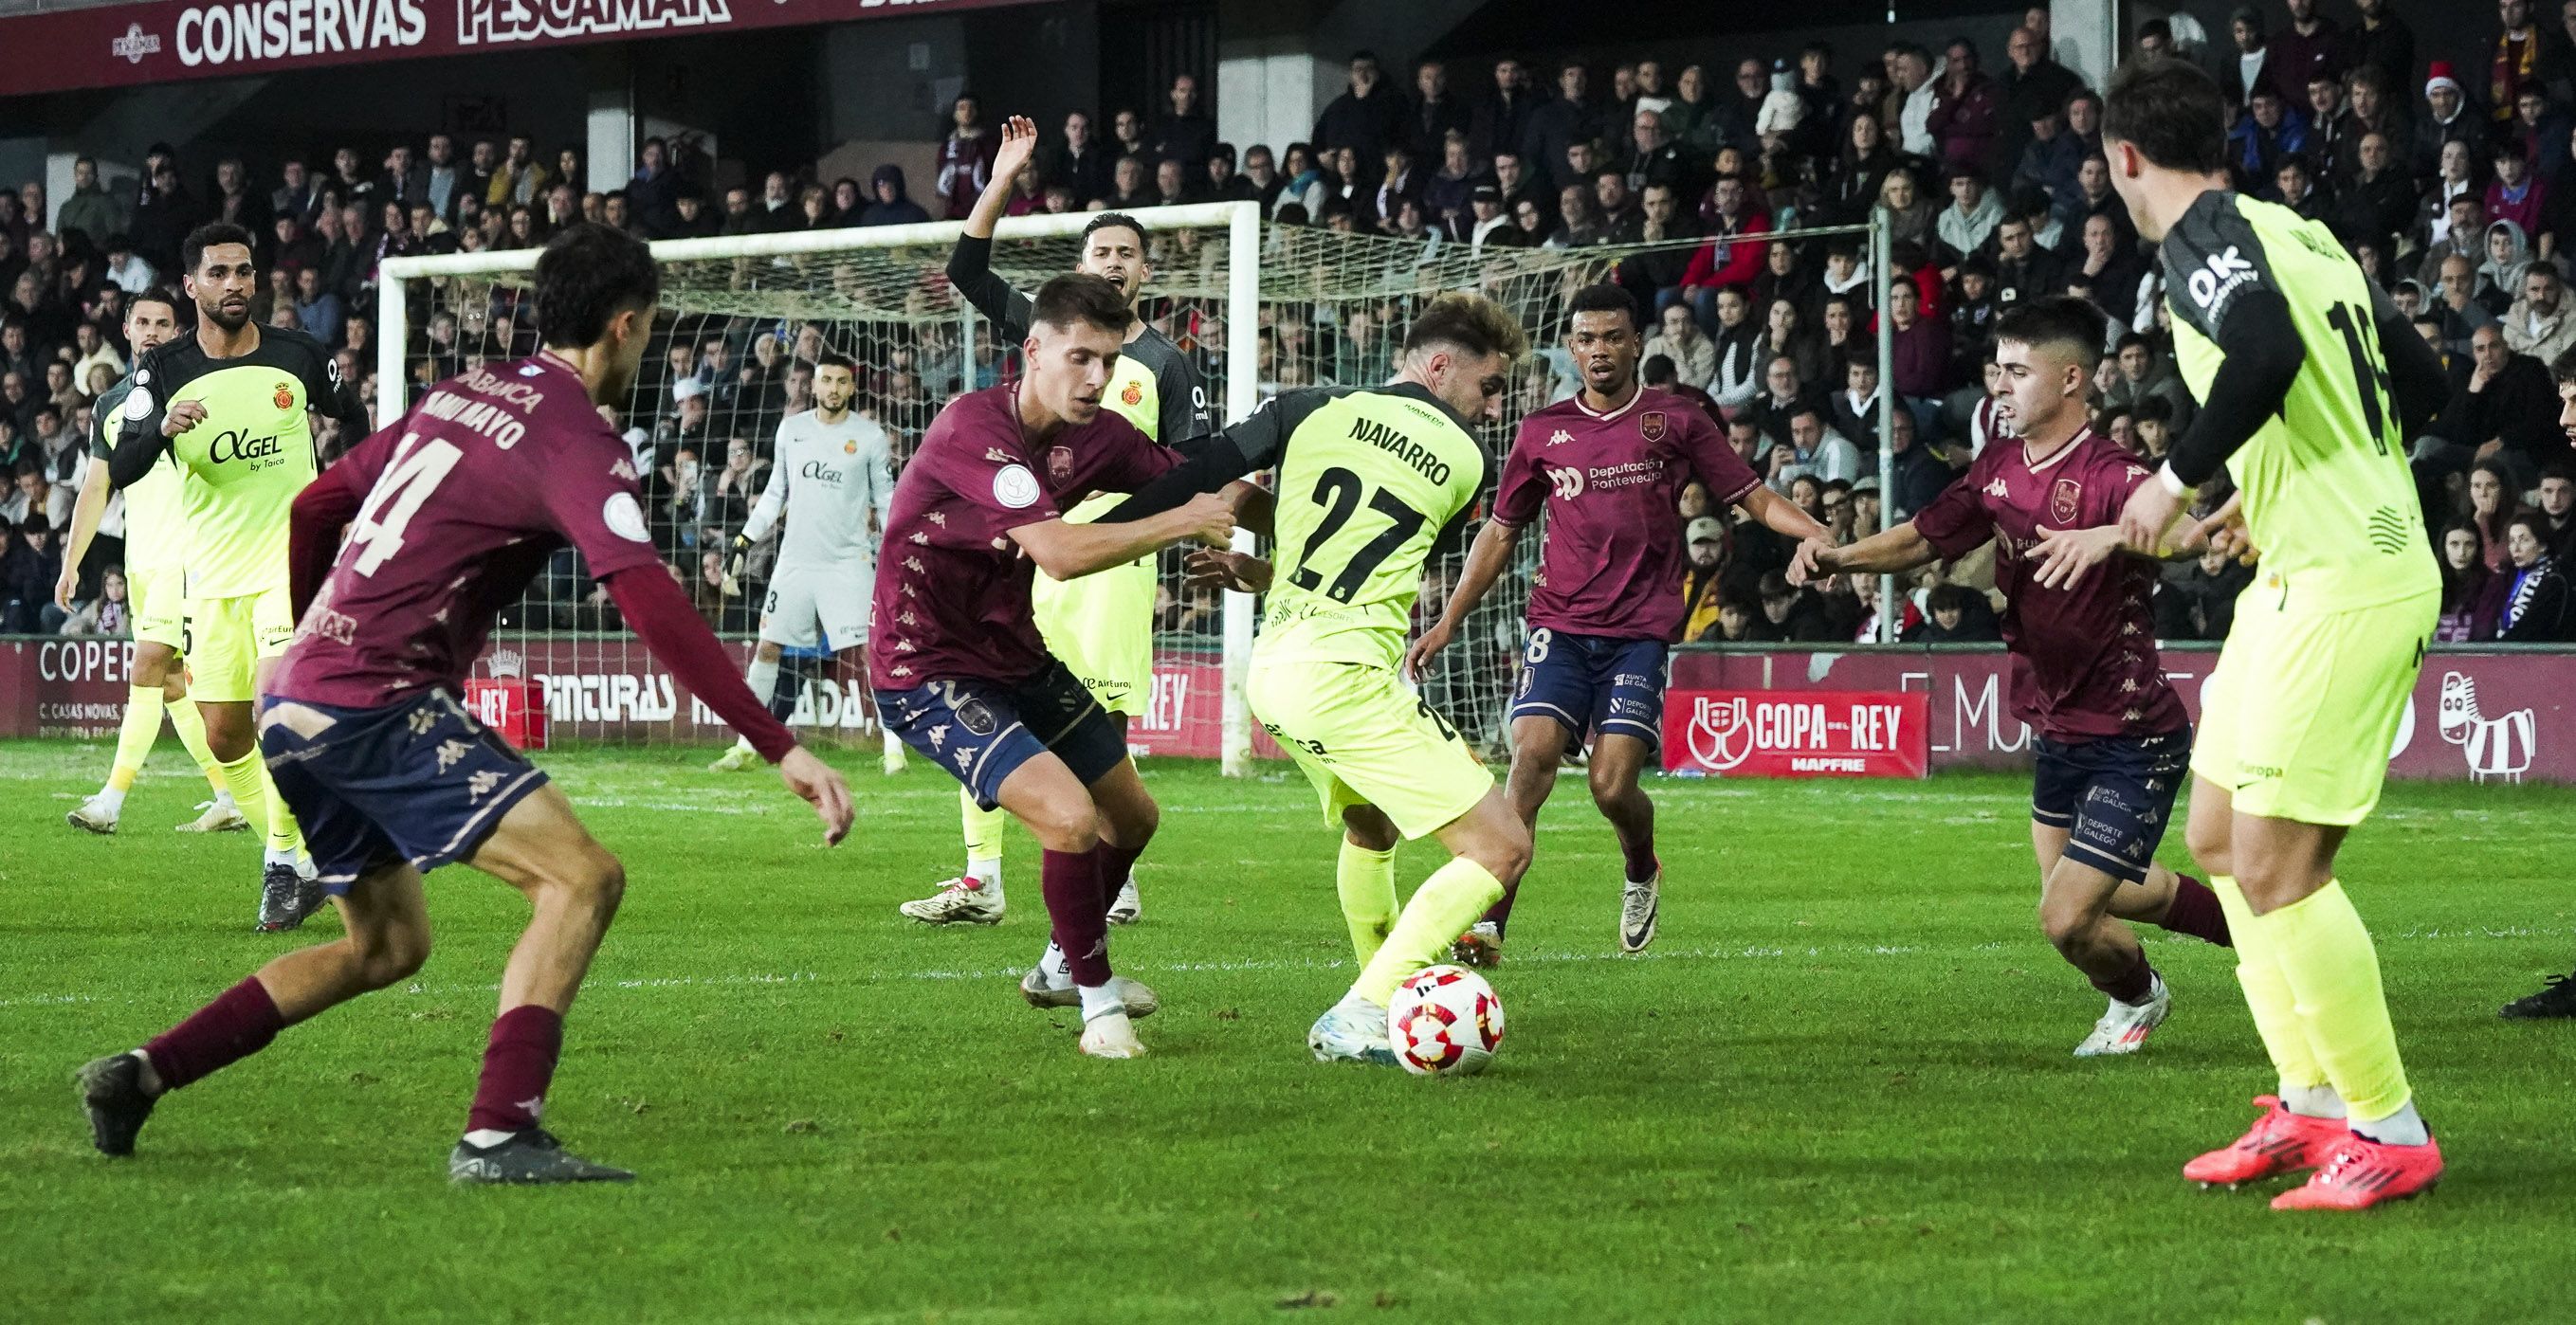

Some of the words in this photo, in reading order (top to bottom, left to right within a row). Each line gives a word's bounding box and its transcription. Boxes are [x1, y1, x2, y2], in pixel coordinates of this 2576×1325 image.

[176, 0, 427, 66] CONSERVAS
[2188, 245, 2253, 308] OK
[455, 368, 544, 414] ABANCA
[1348, 417, 1451, 486] NAVARRO
[1589, 459, 1664, 479] Deputación
[332, 432, 465, 578] 14
[1287, 467, 1427, 605] 27
[51, 702, 83, 719] CASAS
[481, 688, 509, 728] REY
[1142, 673, 1189, 731] REY
[1756, 703, 1828, 750] COPA
[1851, 705, 1902, 751] REY
[1791, 758, 1866, 772] MAPFRE
[2084, 827, 2116, 846] GALEGO
[2087, 818, 2124, 839] DEPORTE
